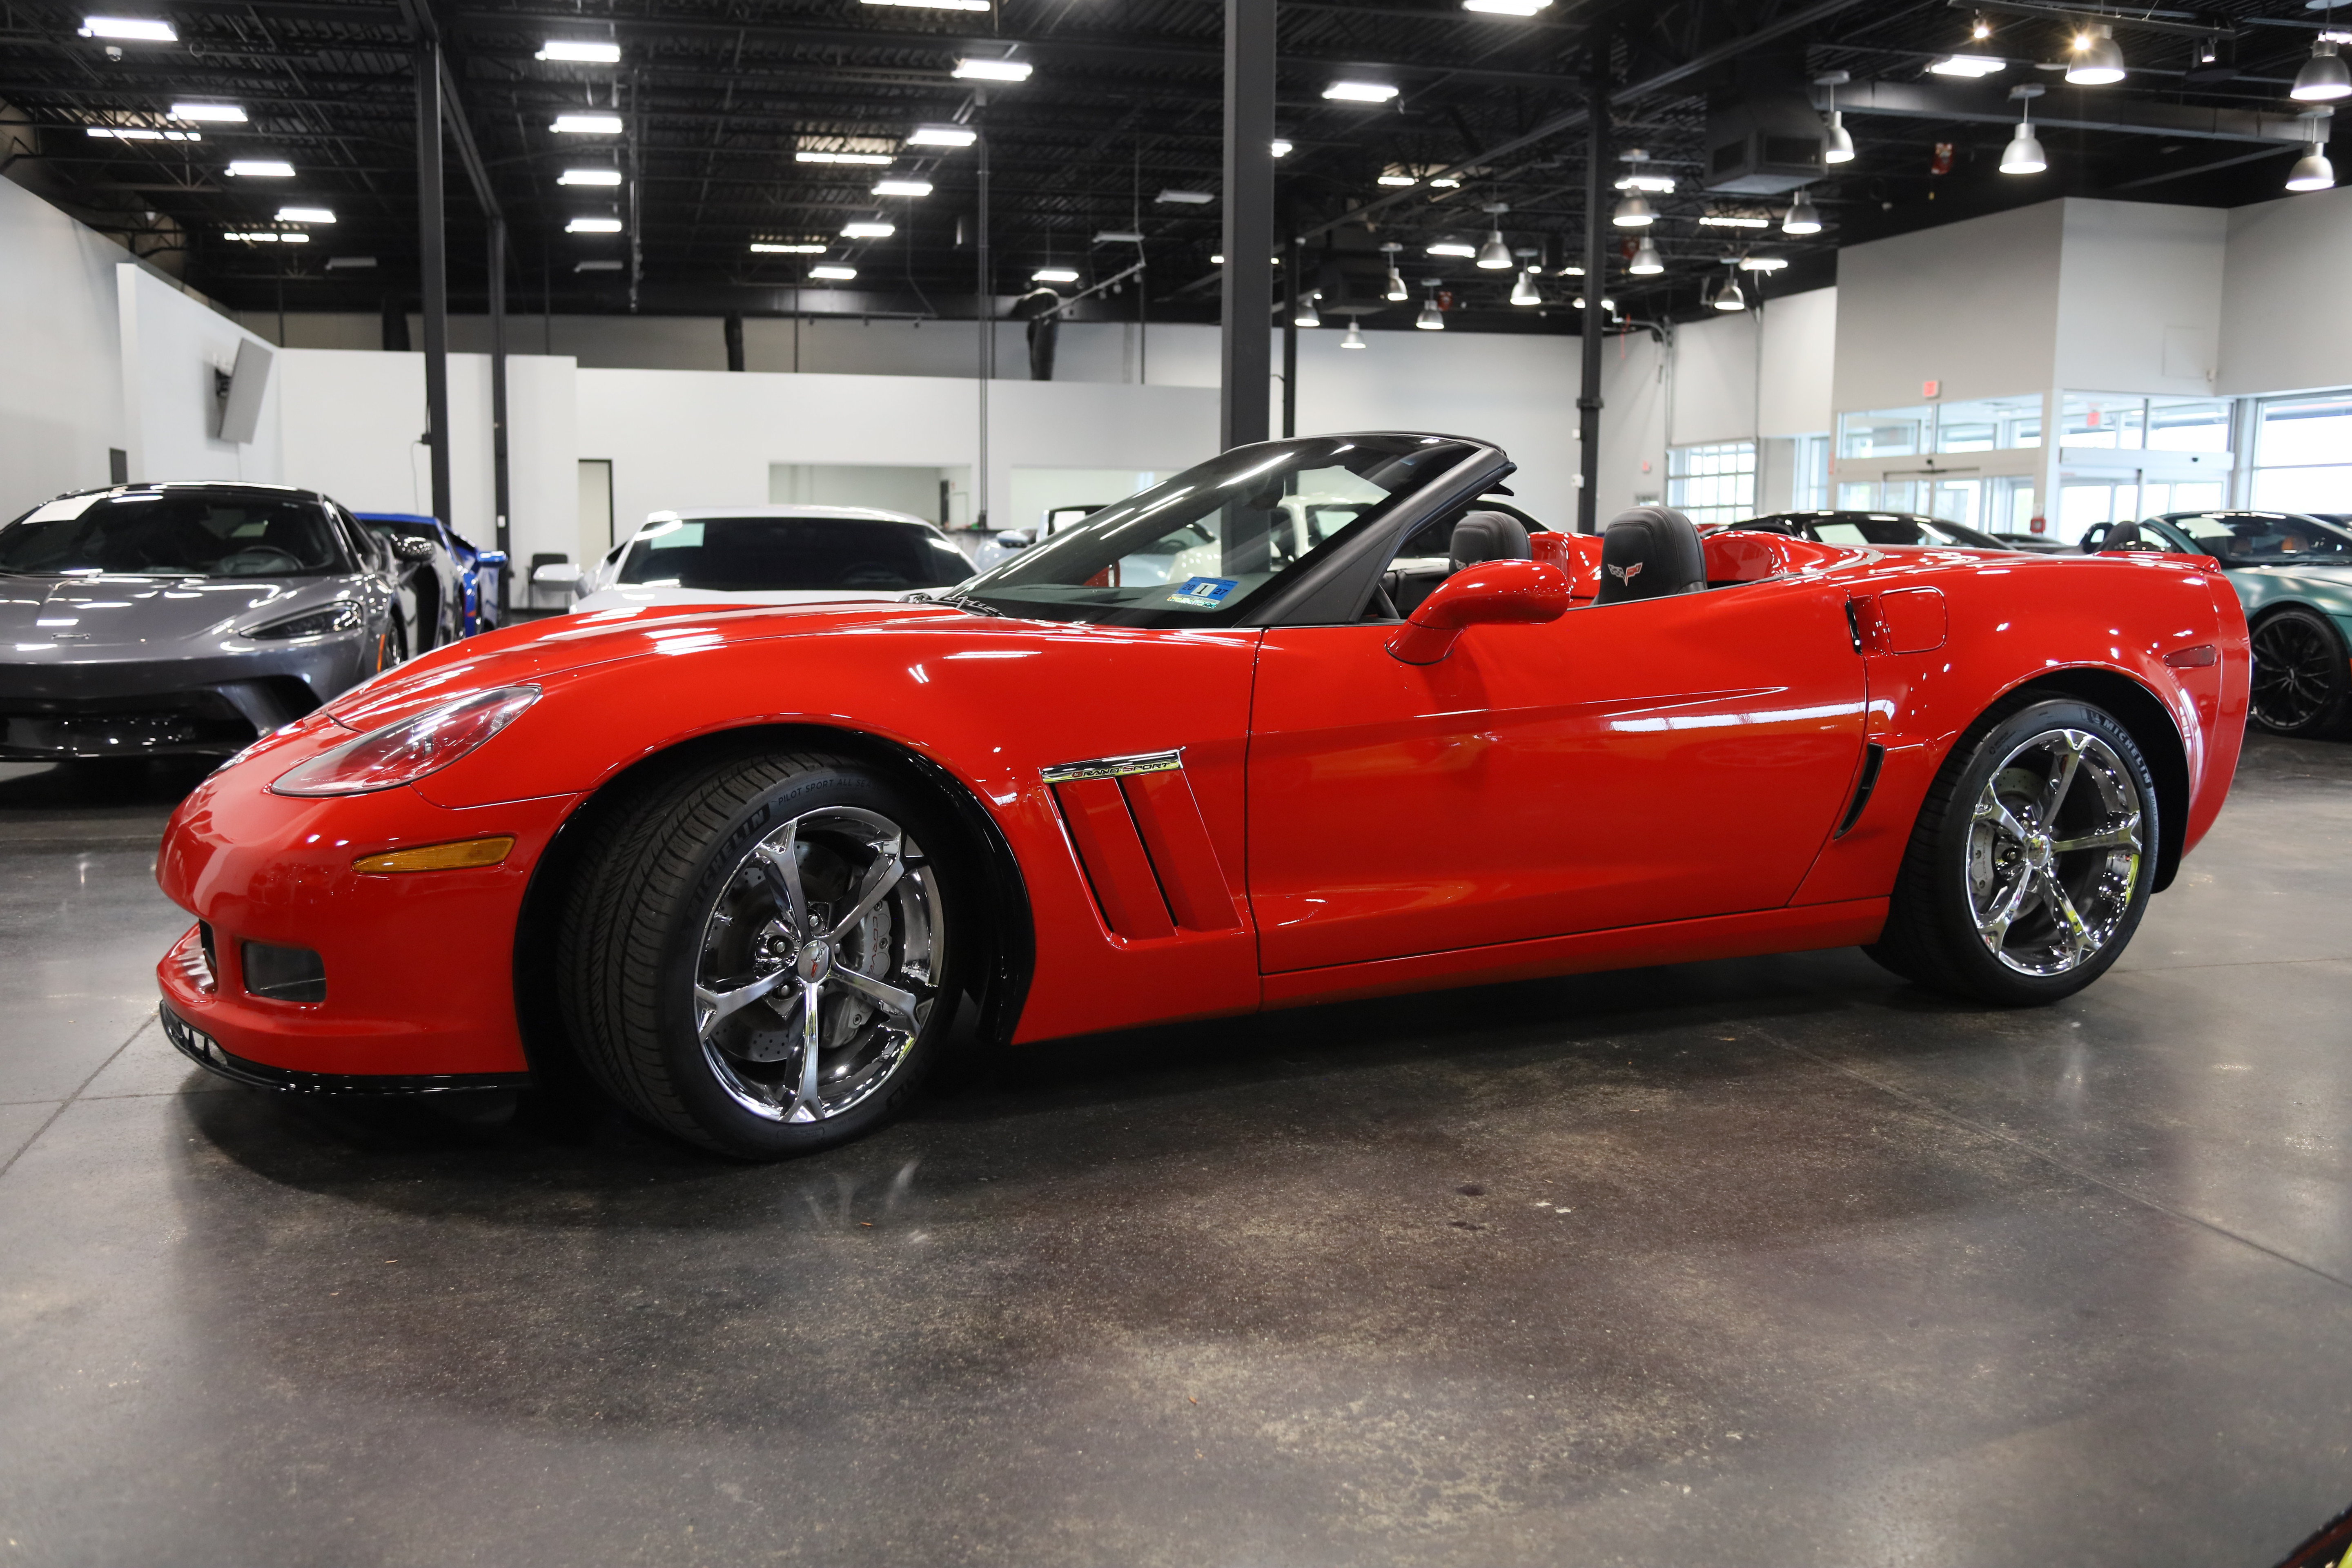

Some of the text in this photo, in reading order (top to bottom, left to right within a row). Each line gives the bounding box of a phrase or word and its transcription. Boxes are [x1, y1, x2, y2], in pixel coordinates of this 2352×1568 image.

[1196, 585, 1209, 594] 1
[2103, 719, 2151, 784] MICHELIN
[1072, 762, 1170, 778] GRAND SPORT
[778, 786, 802, 805] PILOT
[806, 779, 833, 793] SPORT
[837, 778, 852, 786] ALL
[687, 808, 764, 921] MICHELIN
